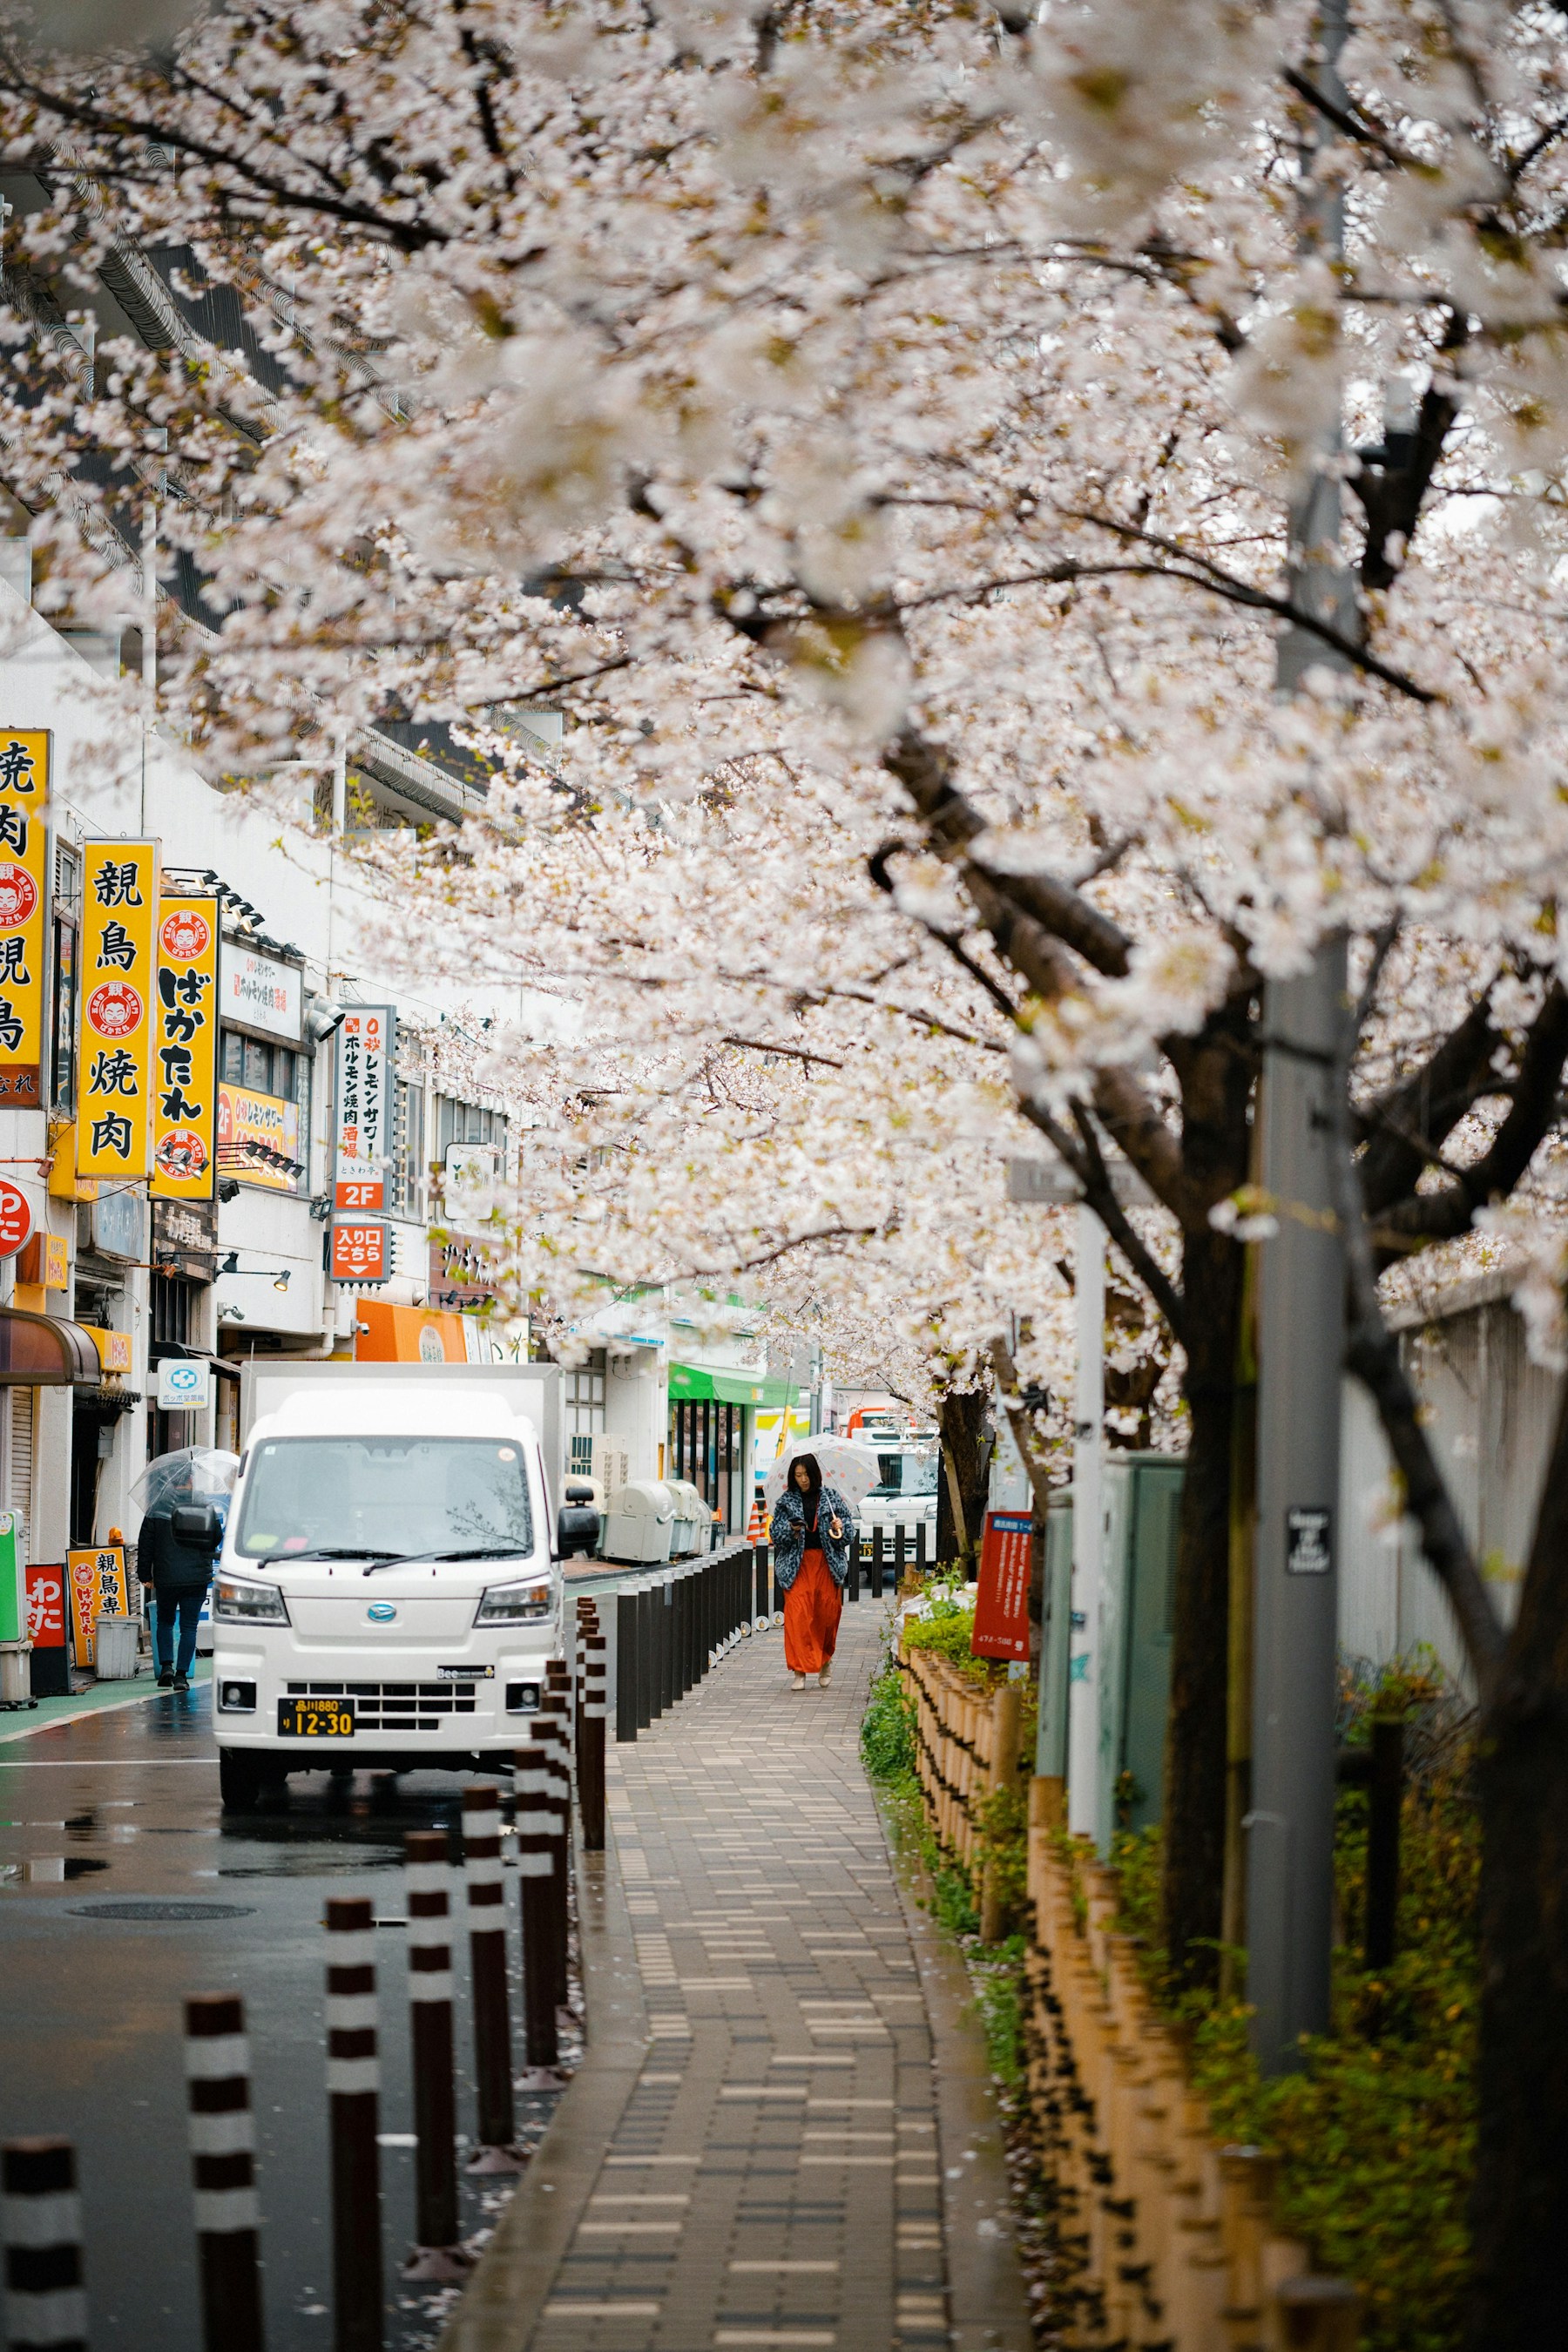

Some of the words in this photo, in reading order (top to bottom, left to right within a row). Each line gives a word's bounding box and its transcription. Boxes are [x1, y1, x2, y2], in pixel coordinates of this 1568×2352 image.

[92, 860, 144, 970] 親鳥
[159, 967, 213, 1123] ばかたれ
[88, 1049, 139, 1159] 焼肉
[345, 1186, 375, 1206] 2F
[336, 1229, 381, 1246] 入り口
[335, 1247, 381, 1262] こちら
[76, 1587, 96, 1636] ばかたれ
[437, 1667, 458, 1680] Bee
[296, 1713, 352, 1735] 12-30
